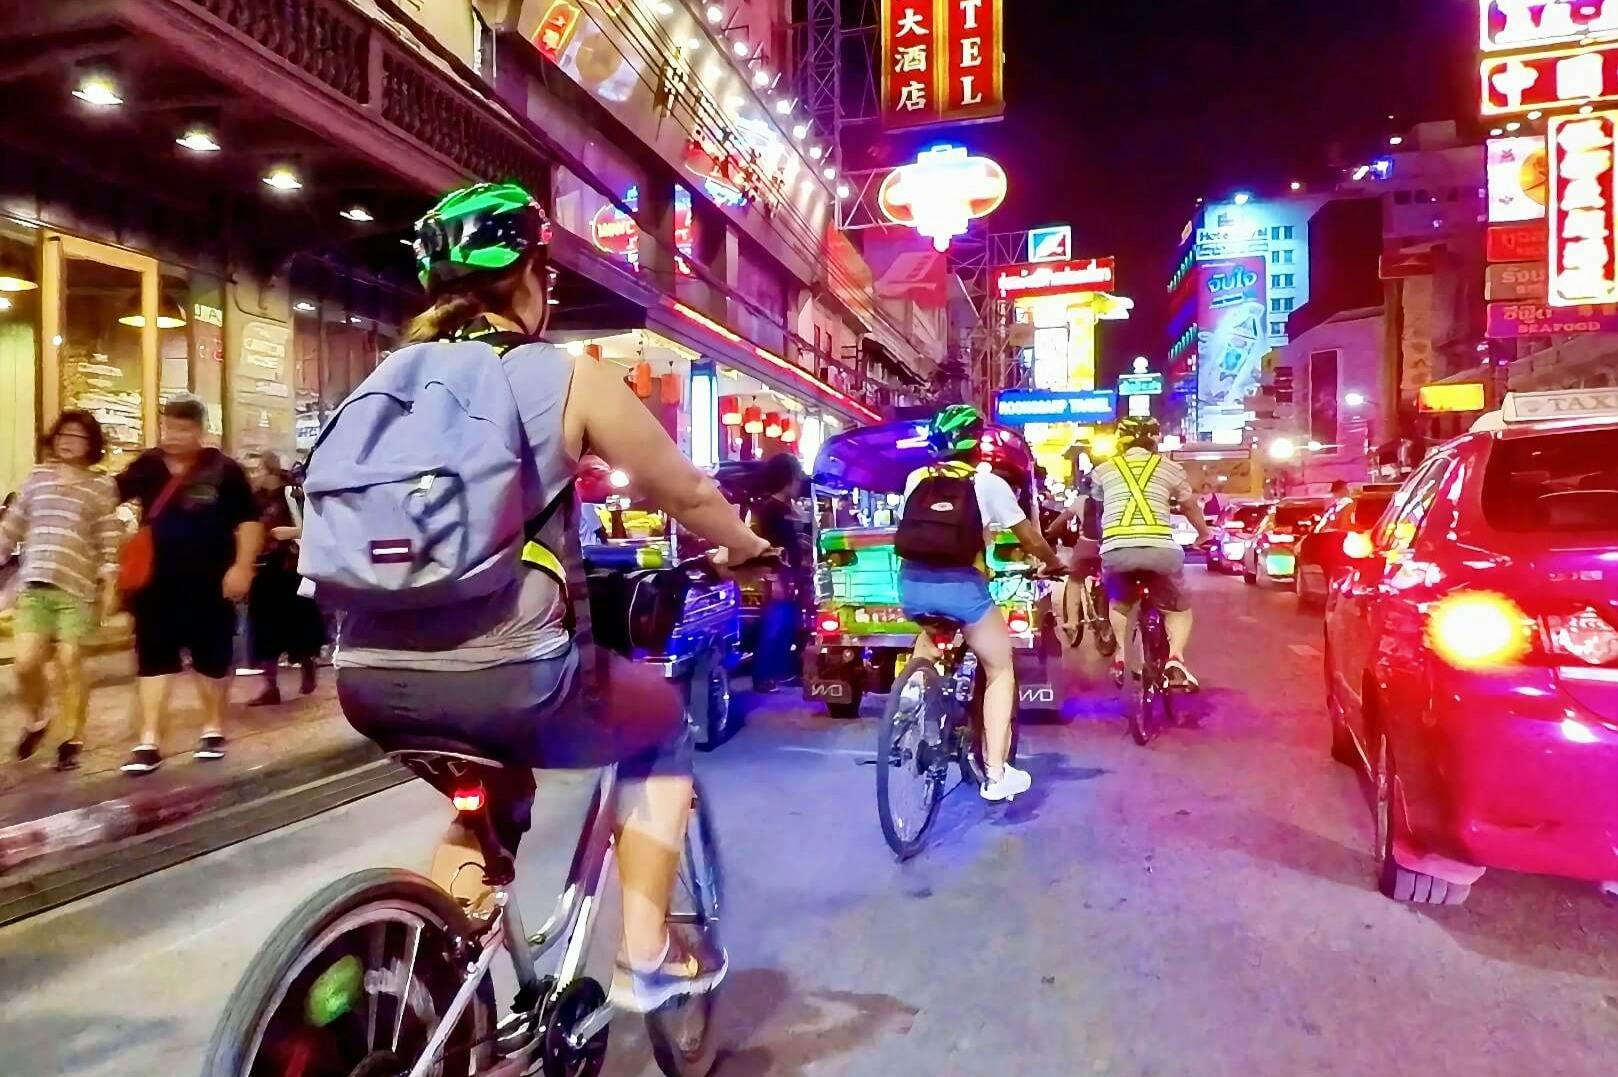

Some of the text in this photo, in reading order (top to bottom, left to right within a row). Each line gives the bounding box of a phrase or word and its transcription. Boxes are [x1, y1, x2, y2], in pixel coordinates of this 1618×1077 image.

[894, 7, 930, 112] 大酒店
[1517, 321, 1601, 334] SEAFOOD
